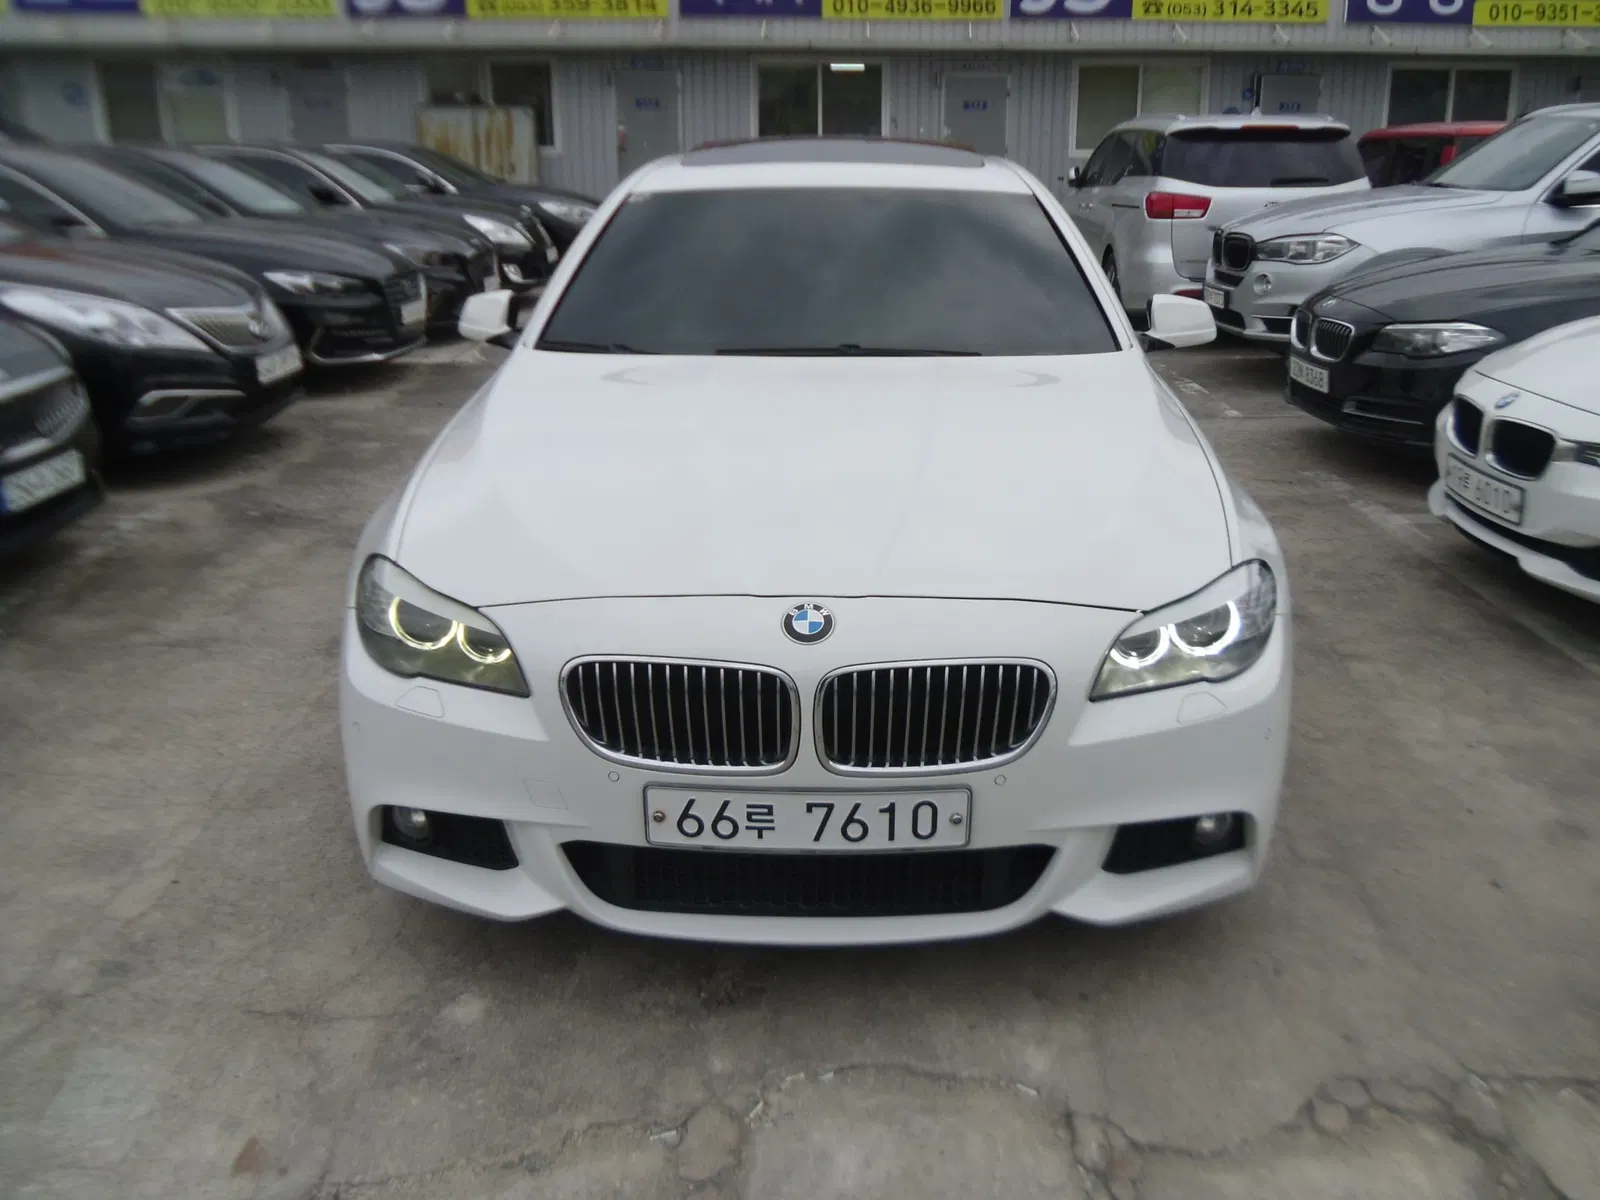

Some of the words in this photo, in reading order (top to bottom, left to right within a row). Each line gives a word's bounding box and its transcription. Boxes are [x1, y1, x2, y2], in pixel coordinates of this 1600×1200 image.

[832, 0, 997, 14] 010-4936-9966
[1212, 0, 1319, 18] 314-3345
[788, 603, 830, 616] BMW
[676, 798, 776, 840] 66루
[805, 799, 939, 842] 7610
